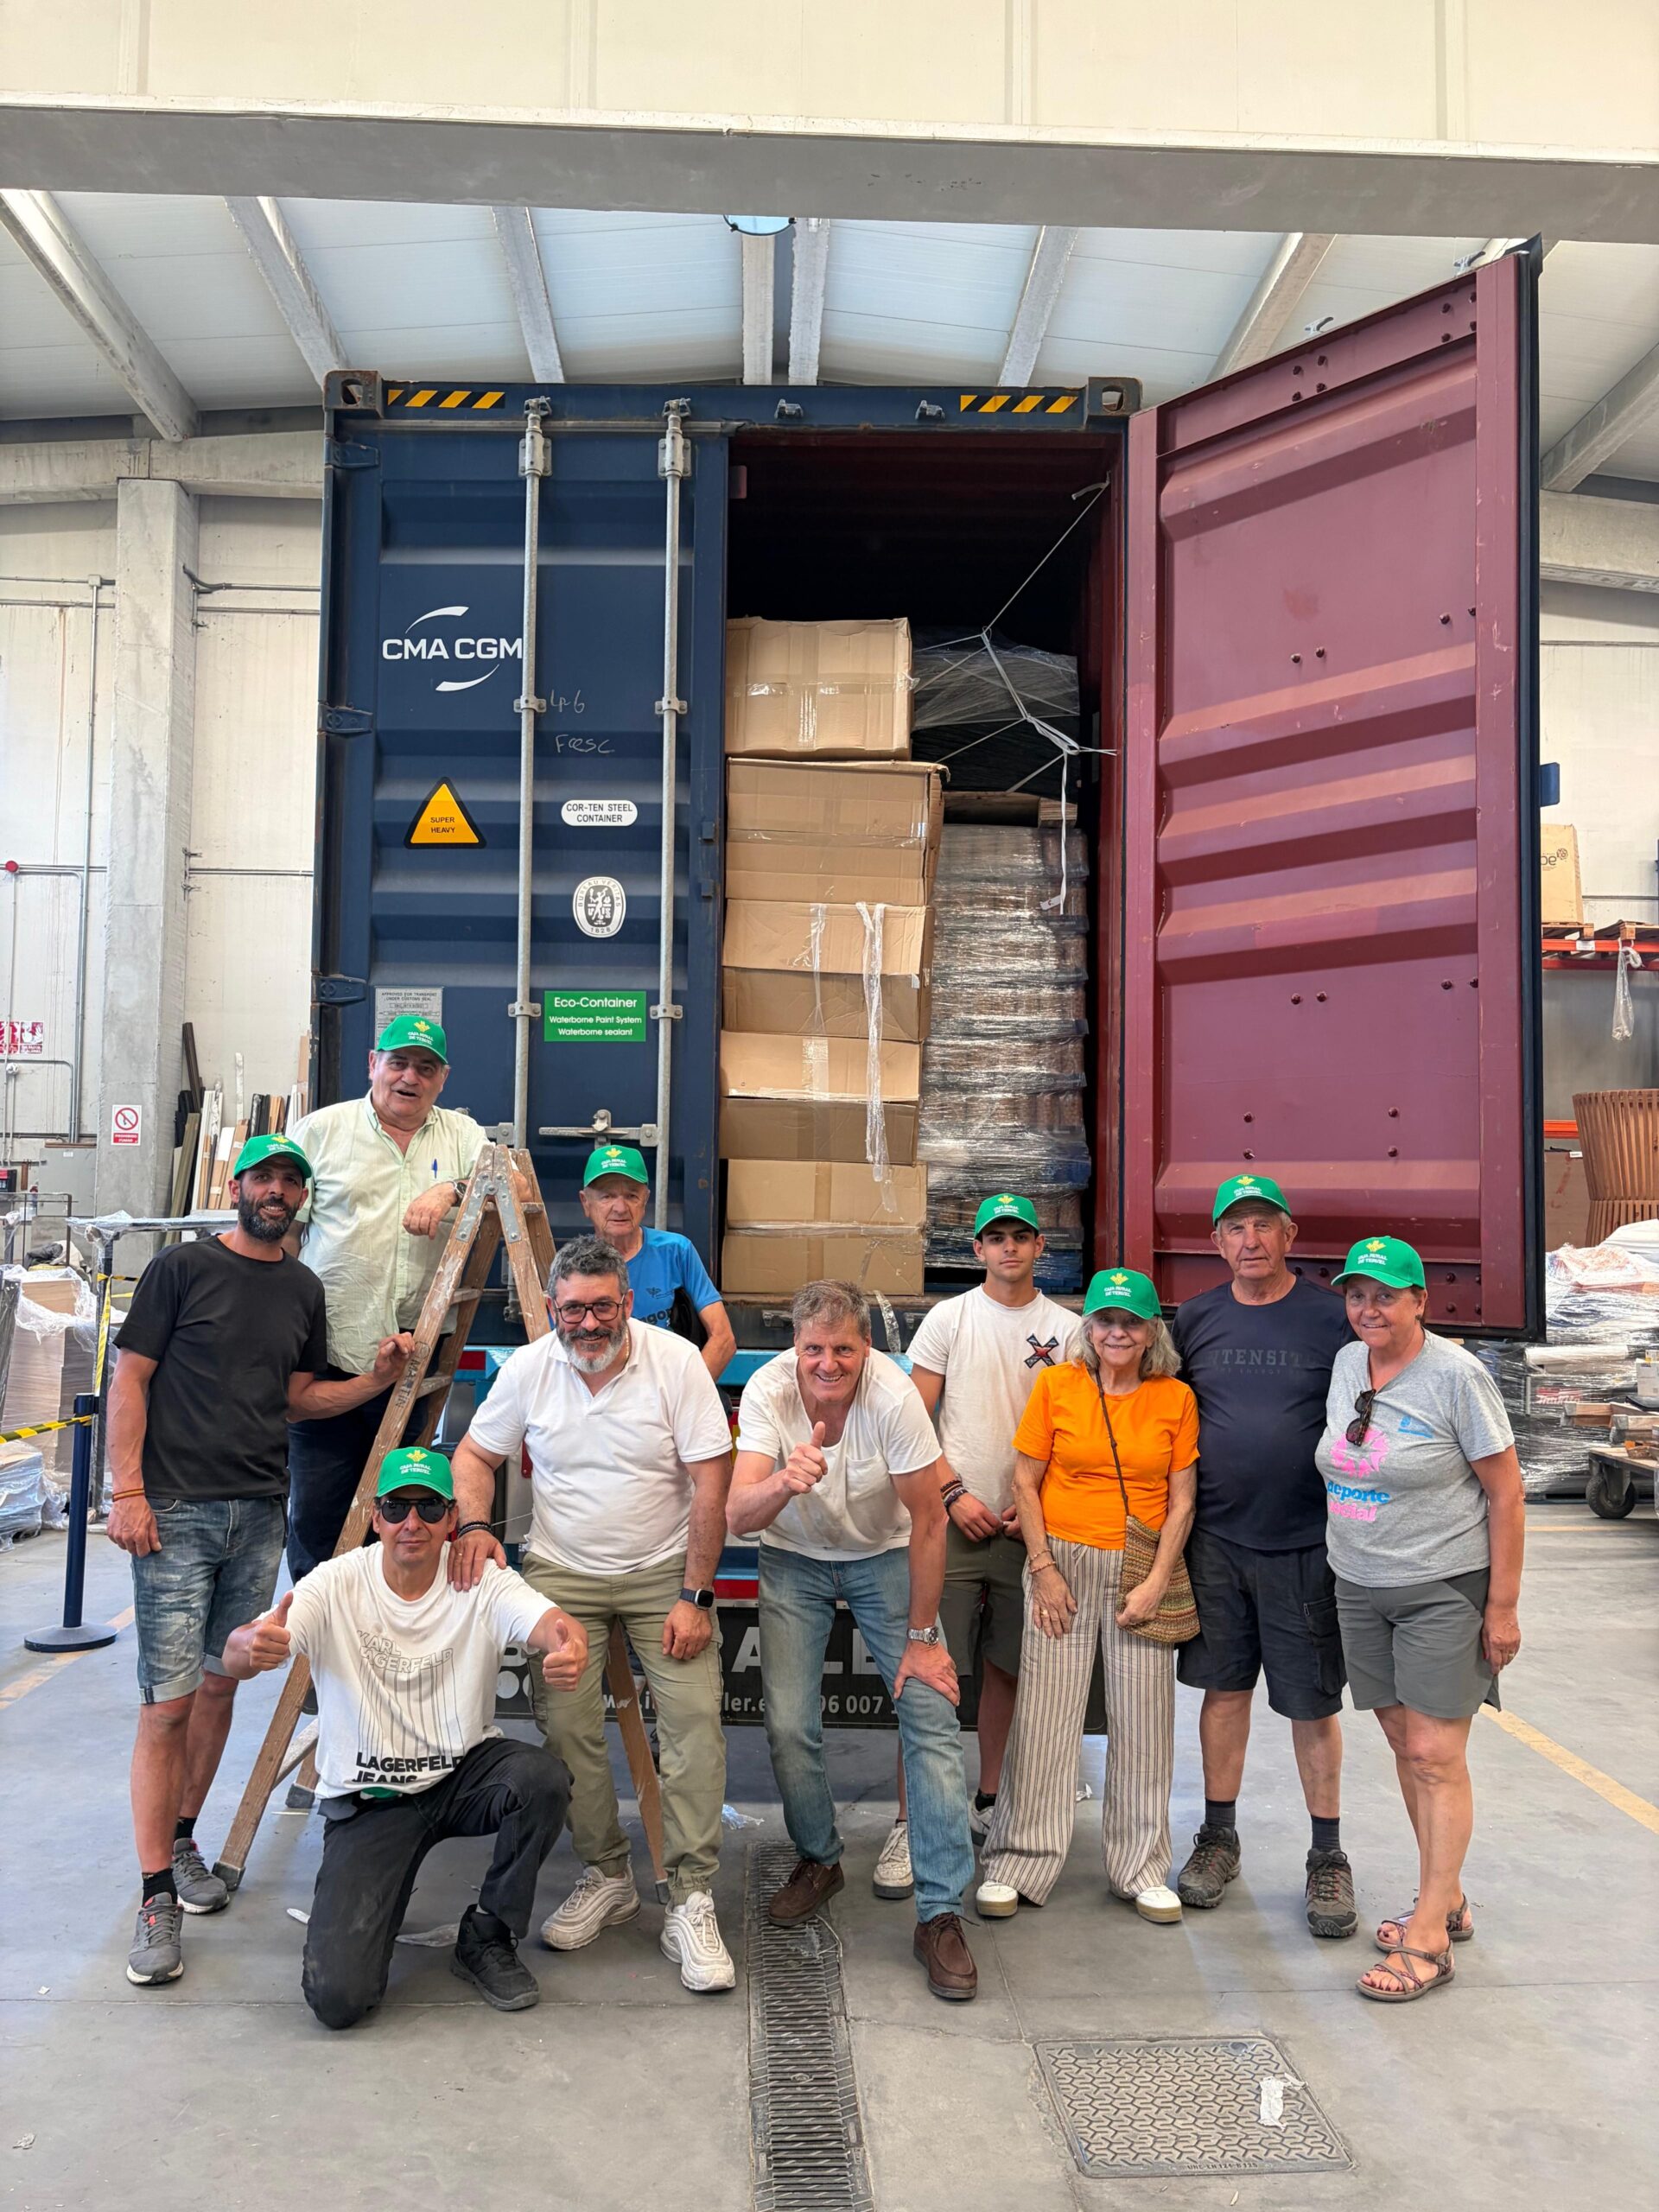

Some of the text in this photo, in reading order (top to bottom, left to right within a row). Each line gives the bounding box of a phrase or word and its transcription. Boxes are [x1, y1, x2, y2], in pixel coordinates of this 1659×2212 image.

[382, 638, 523, 660] CMA CGM
[566, 803, 633, 812] COR-TEN STEEL
[576, 814, 623, 823] CONTAINER
[554, 996, 638, 1008] Eco-Container
[550, 1015, 642, 1026] Waterborne Paint System
[357, 1630, 402, 1657] KARL
[846, 1694, 884, 1714] 007
[356, 1751, 465, 1773] LAGERFELD
